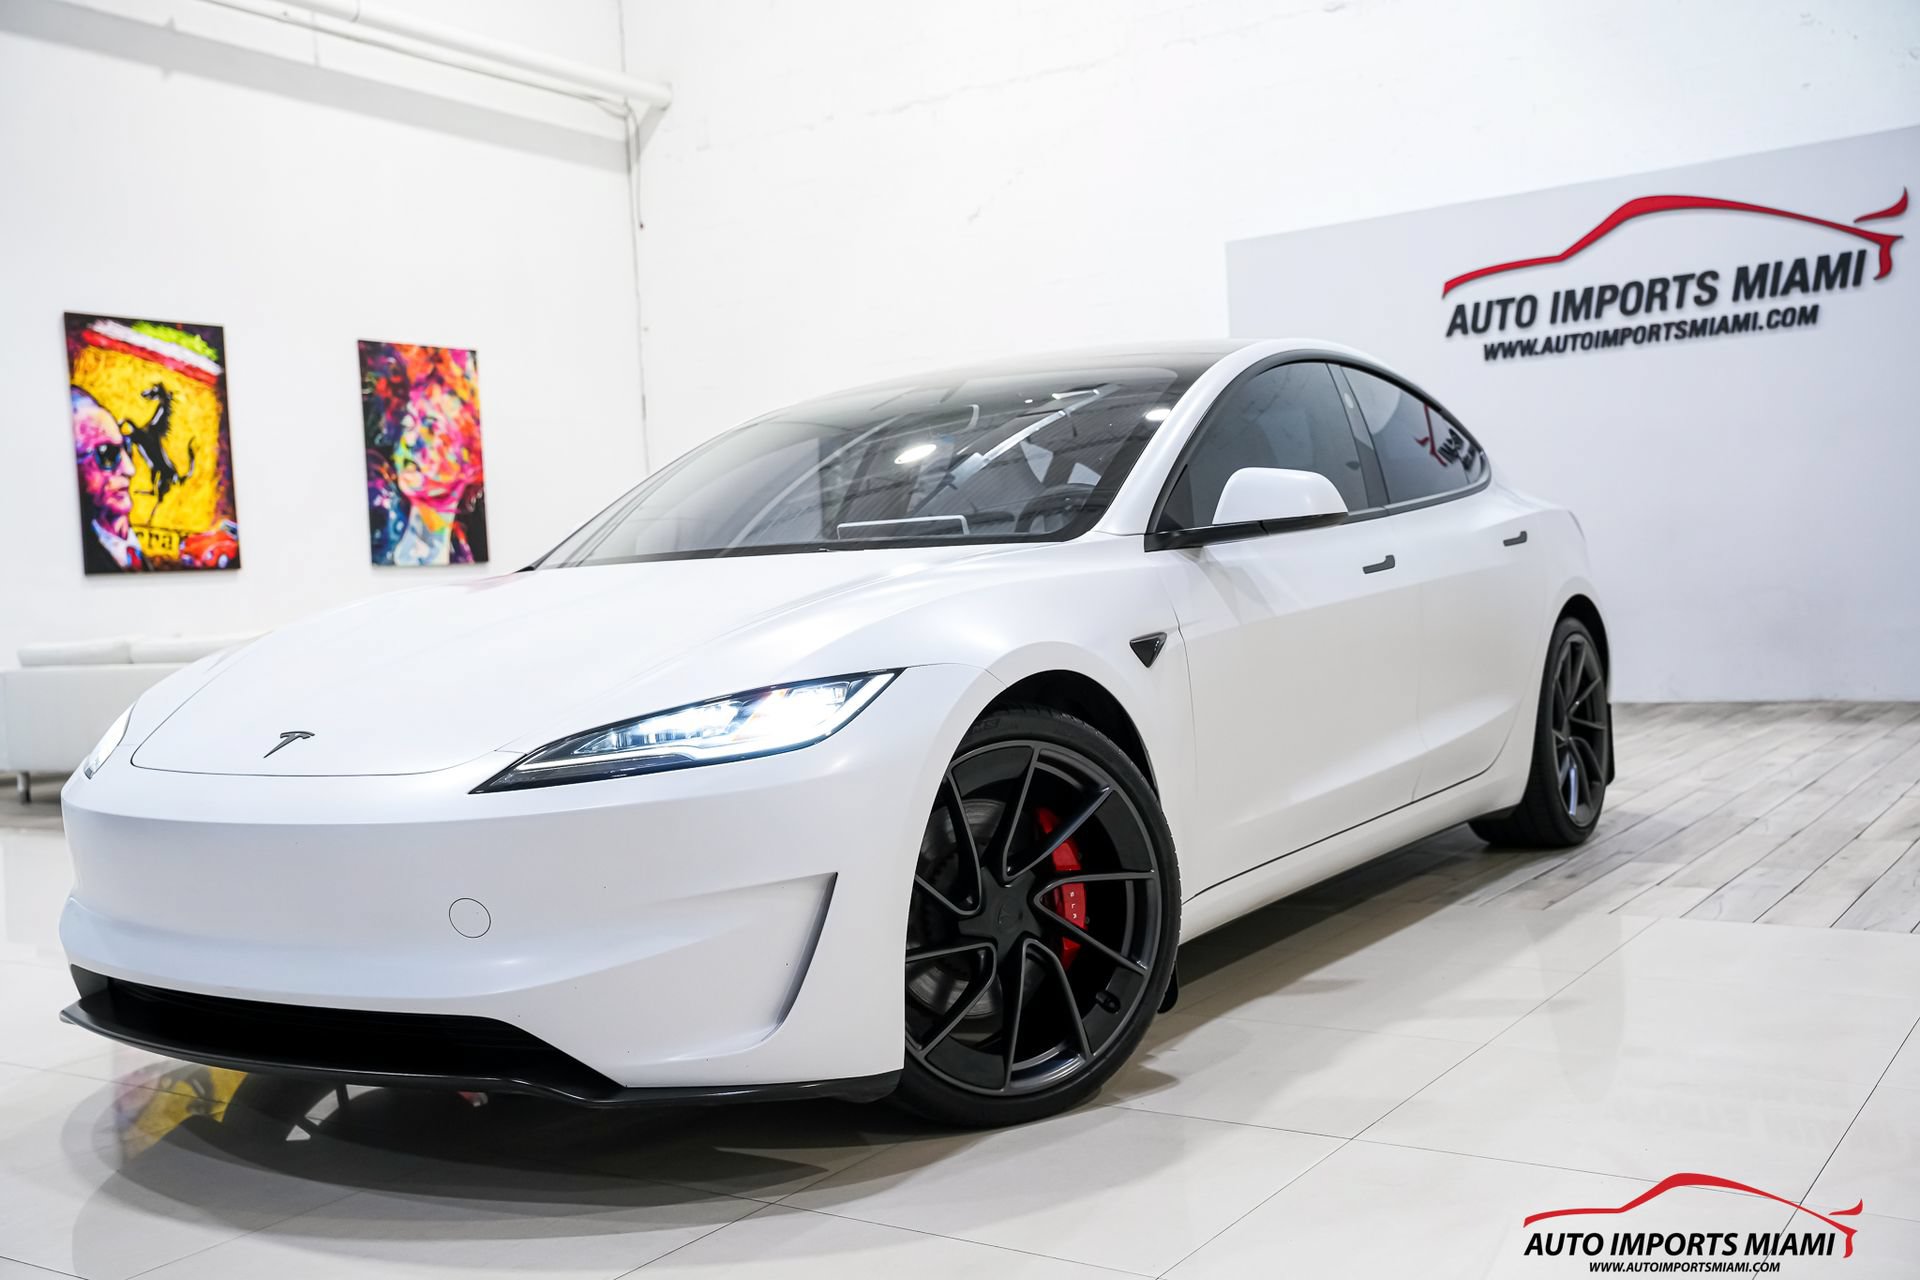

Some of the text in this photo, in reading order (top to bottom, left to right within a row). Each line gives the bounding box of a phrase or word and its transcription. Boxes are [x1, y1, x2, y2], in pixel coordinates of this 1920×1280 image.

[1445, 249, 1868, 338] AUTO IMPORTS MIAMI
[1483, 303, 1820, 361] WWW.AUTOIMPORTSMIAMI.COM
